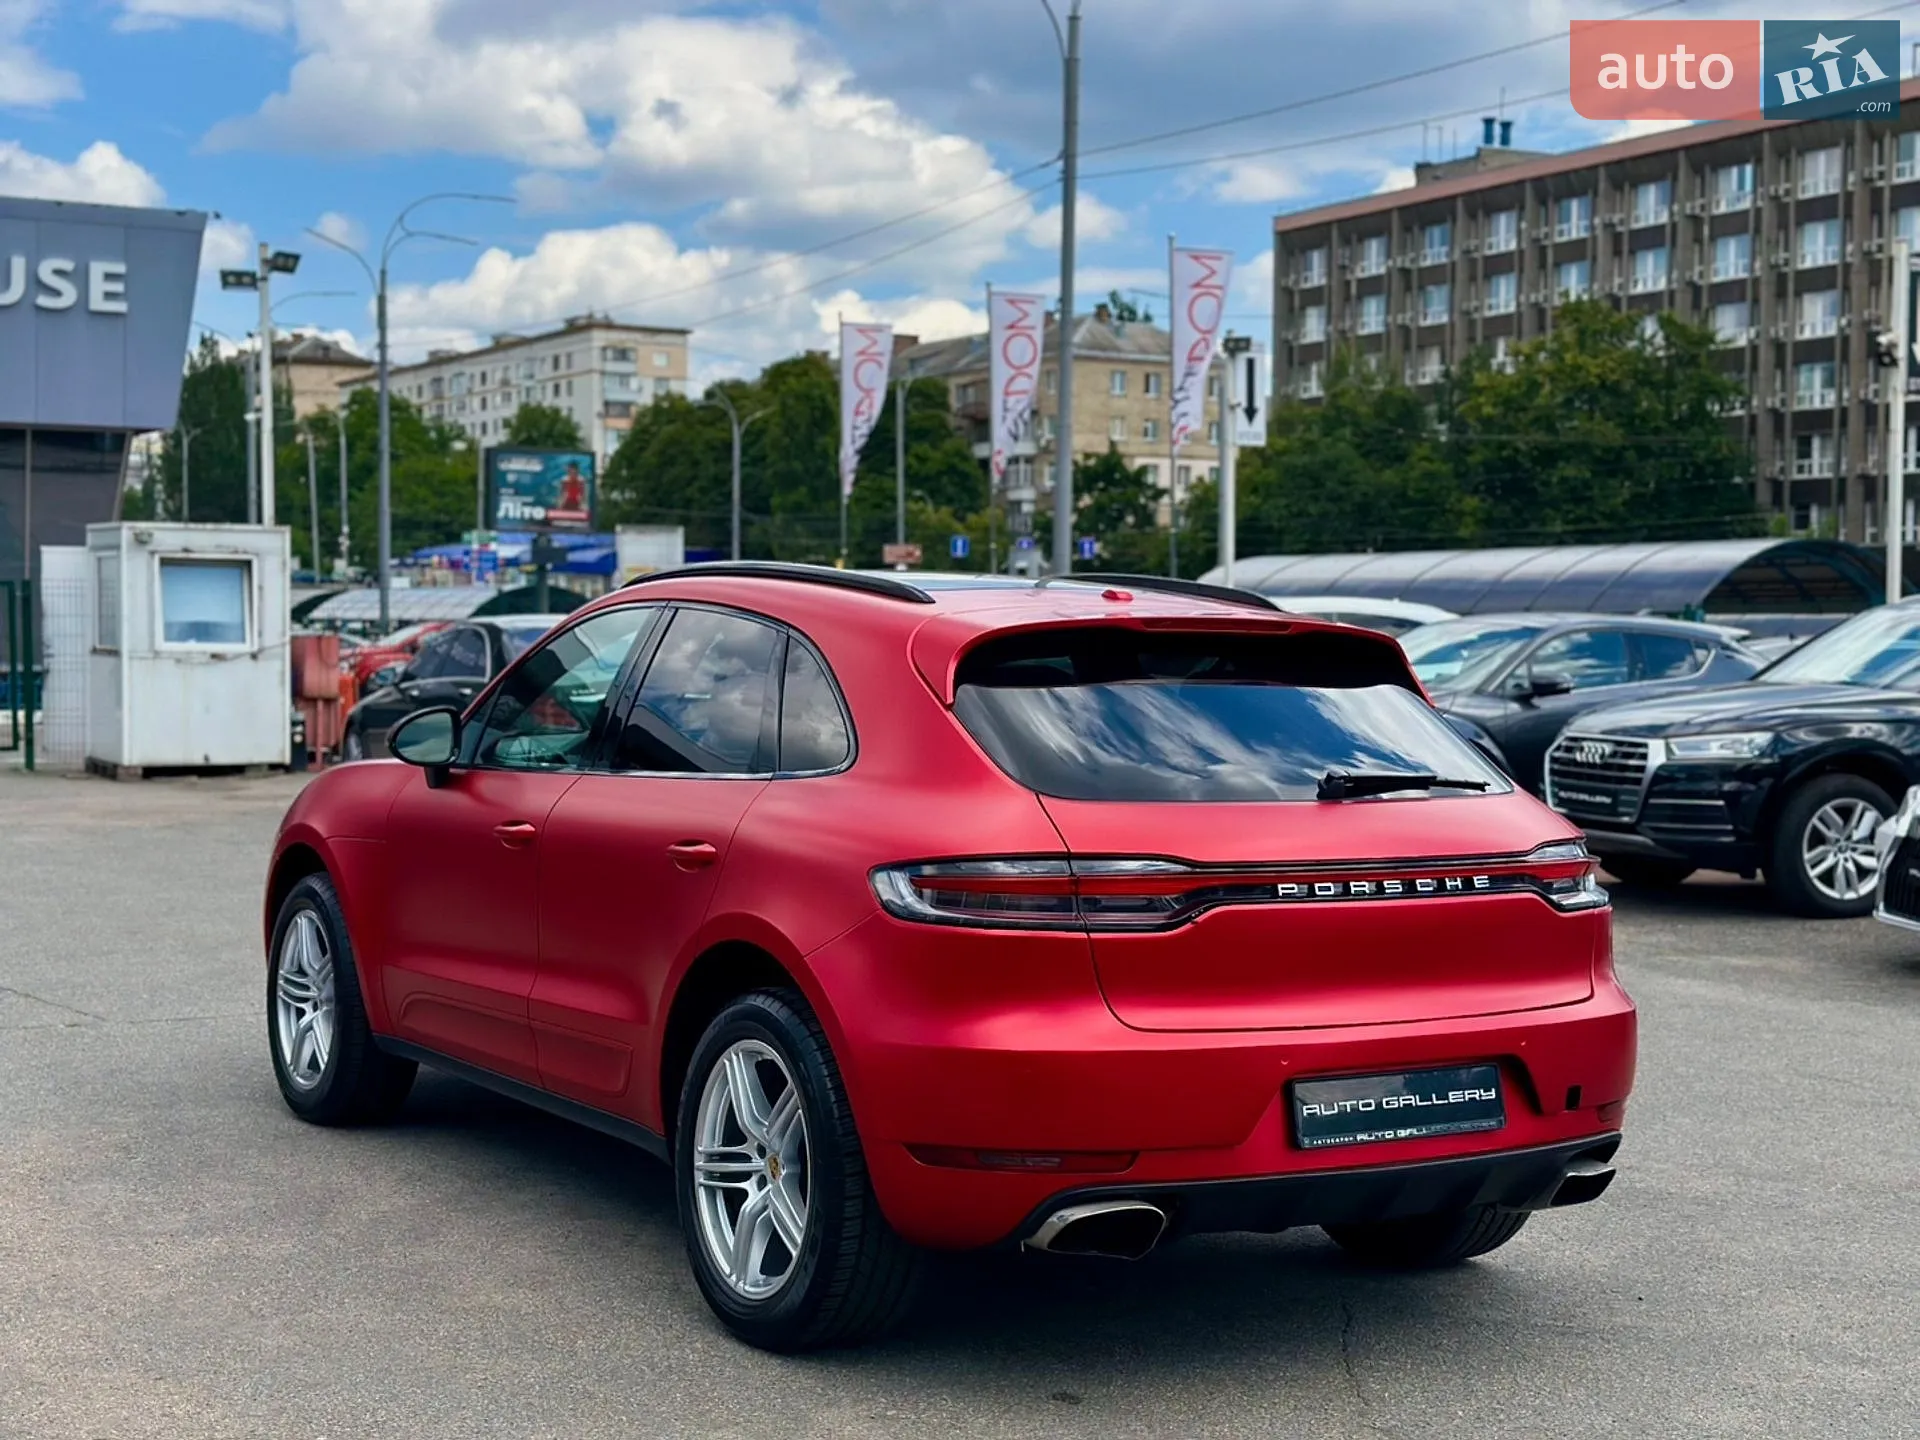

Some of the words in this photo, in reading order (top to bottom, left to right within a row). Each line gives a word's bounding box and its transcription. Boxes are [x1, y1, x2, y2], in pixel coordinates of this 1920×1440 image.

[1277, 875, 1490, 897] PORSCHE
[1302, 1099, 1376, 1117] AUTO
[1382, 1087, 1496, 1109] GALLERY
